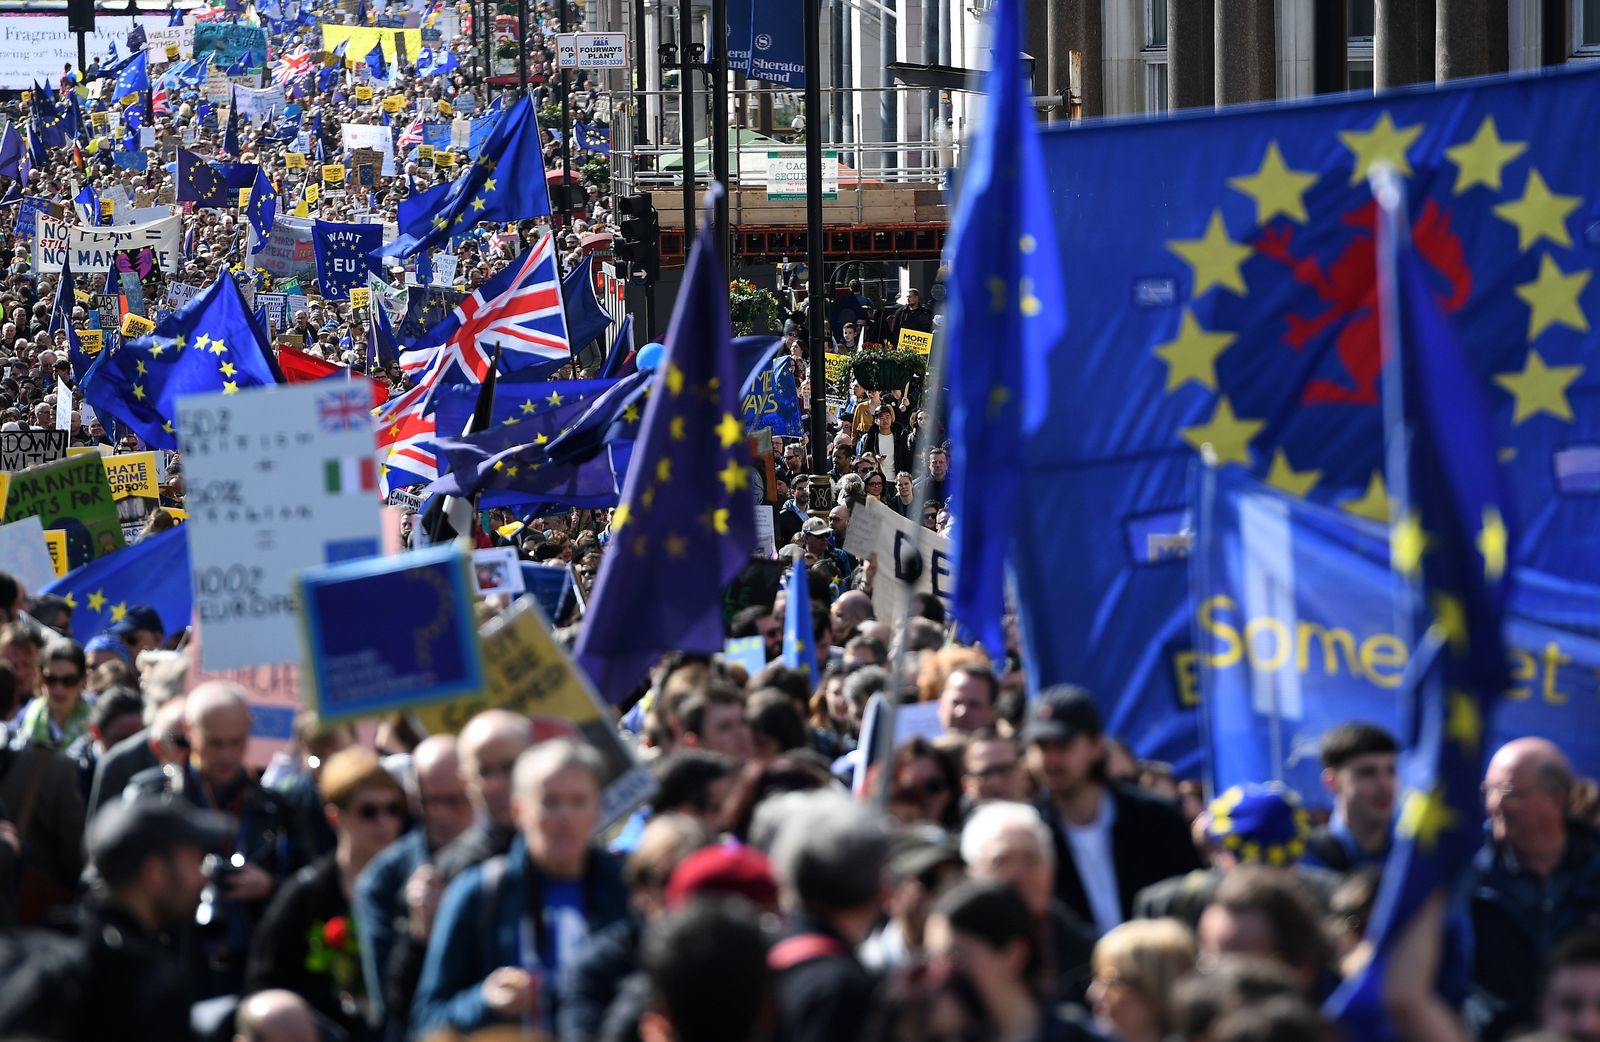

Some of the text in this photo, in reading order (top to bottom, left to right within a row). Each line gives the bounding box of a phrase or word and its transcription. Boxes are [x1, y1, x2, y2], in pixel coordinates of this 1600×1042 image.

[5, 27, 77, 44] Fragranc
[149, 30, 181, 40] WALES
[728, 60, 749, 69] and
[752, 68, 790, 83] Grand
[44, 222, 69, 241] NO
[327, 232, 362, 244] WANT
[78, 249, 170, 268] MANE
[334, 258, 356, 273] EU
[171, 282, 182, 294] IS
[325, 280, 338, 296] TO
[903, 333, 929, 345] MORE
[741, 393, 779, 416] AYS
[3, 430, 64, 453] DOWN
[2, 451, 58, 471] WITH
[107, 462, 146, 476] HATE
[8, 463, 105, 507] UARANTEE
[107, 471, 148, 485] CRIME
[125, 481, 149, 492] 50%
[71, 486, 104, 511] FOR
[1197, 593, 1572, 702] Someet
